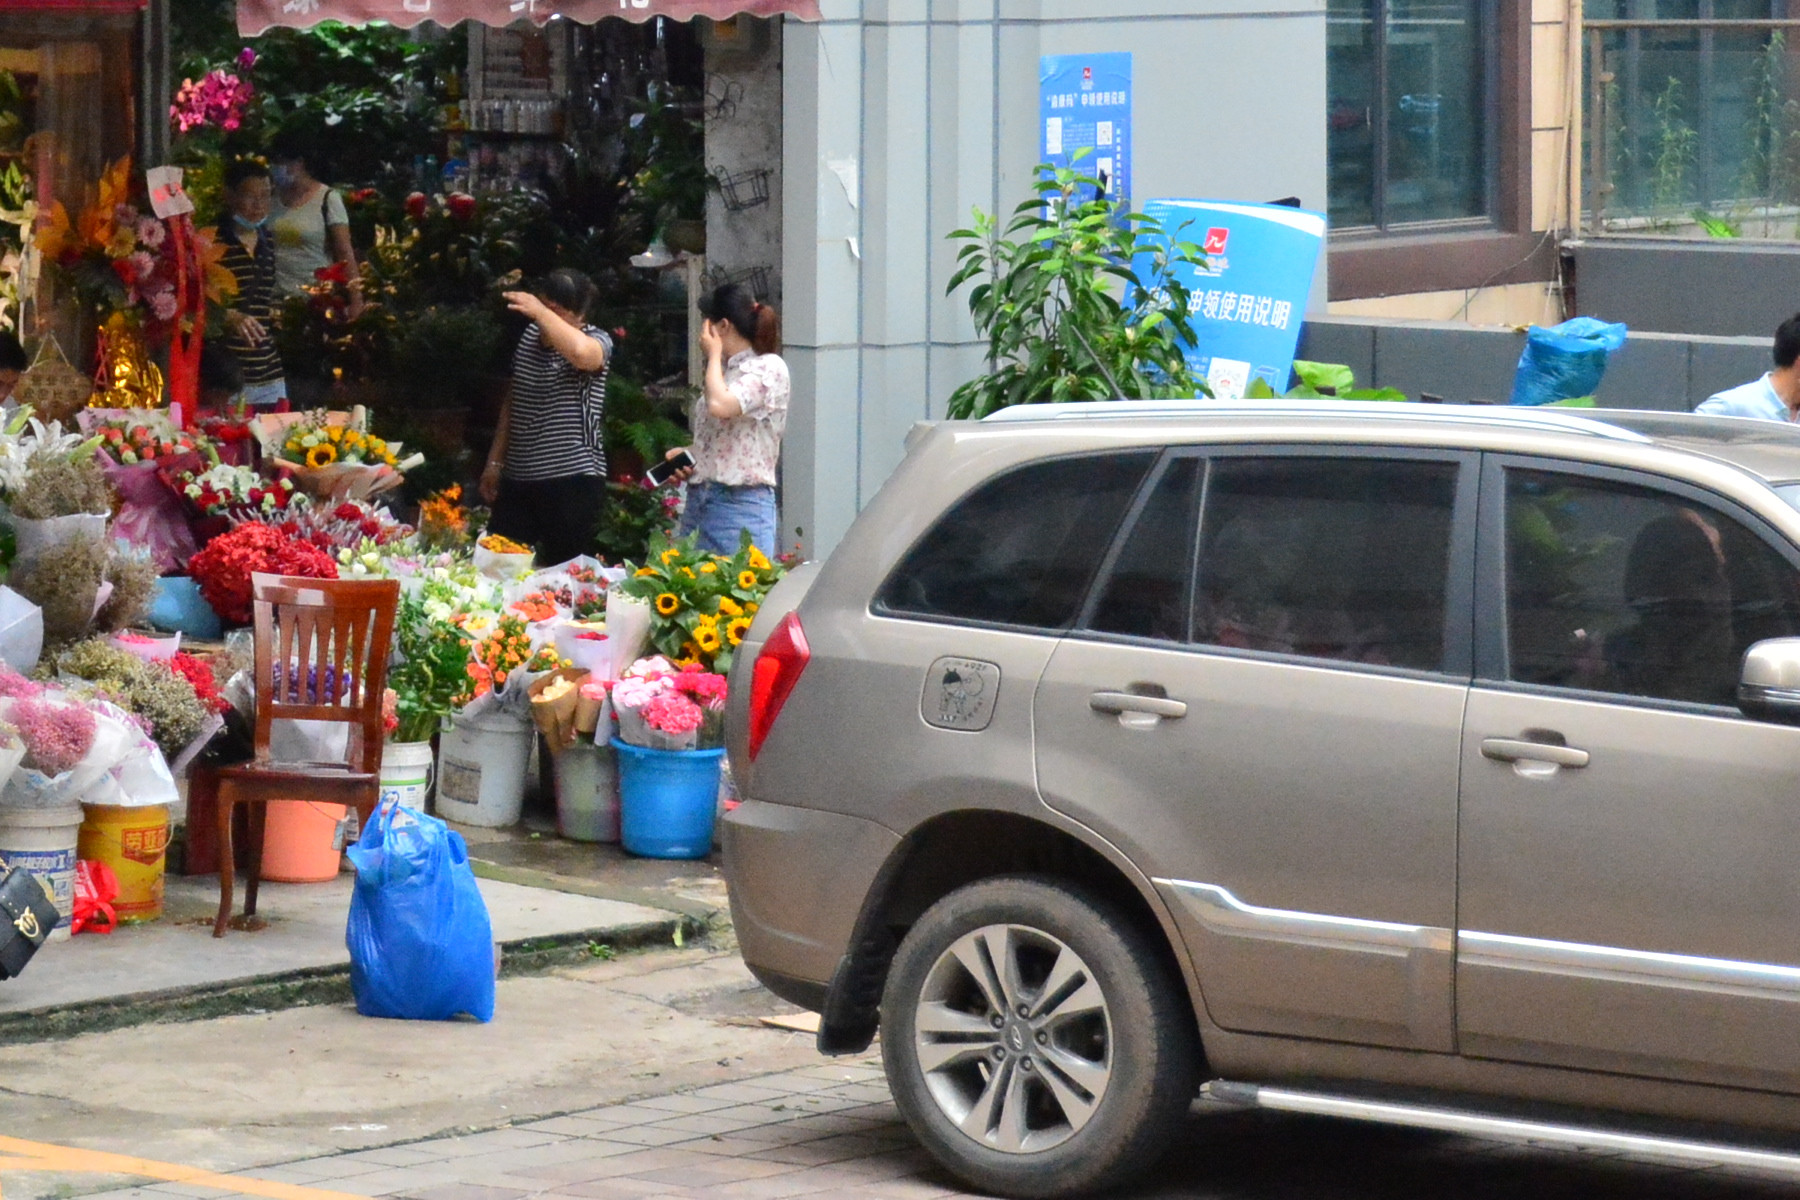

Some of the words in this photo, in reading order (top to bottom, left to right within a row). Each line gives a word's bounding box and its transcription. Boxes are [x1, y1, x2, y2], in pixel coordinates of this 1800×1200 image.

[1188, 287, 1292, 331] 申领使用说明
